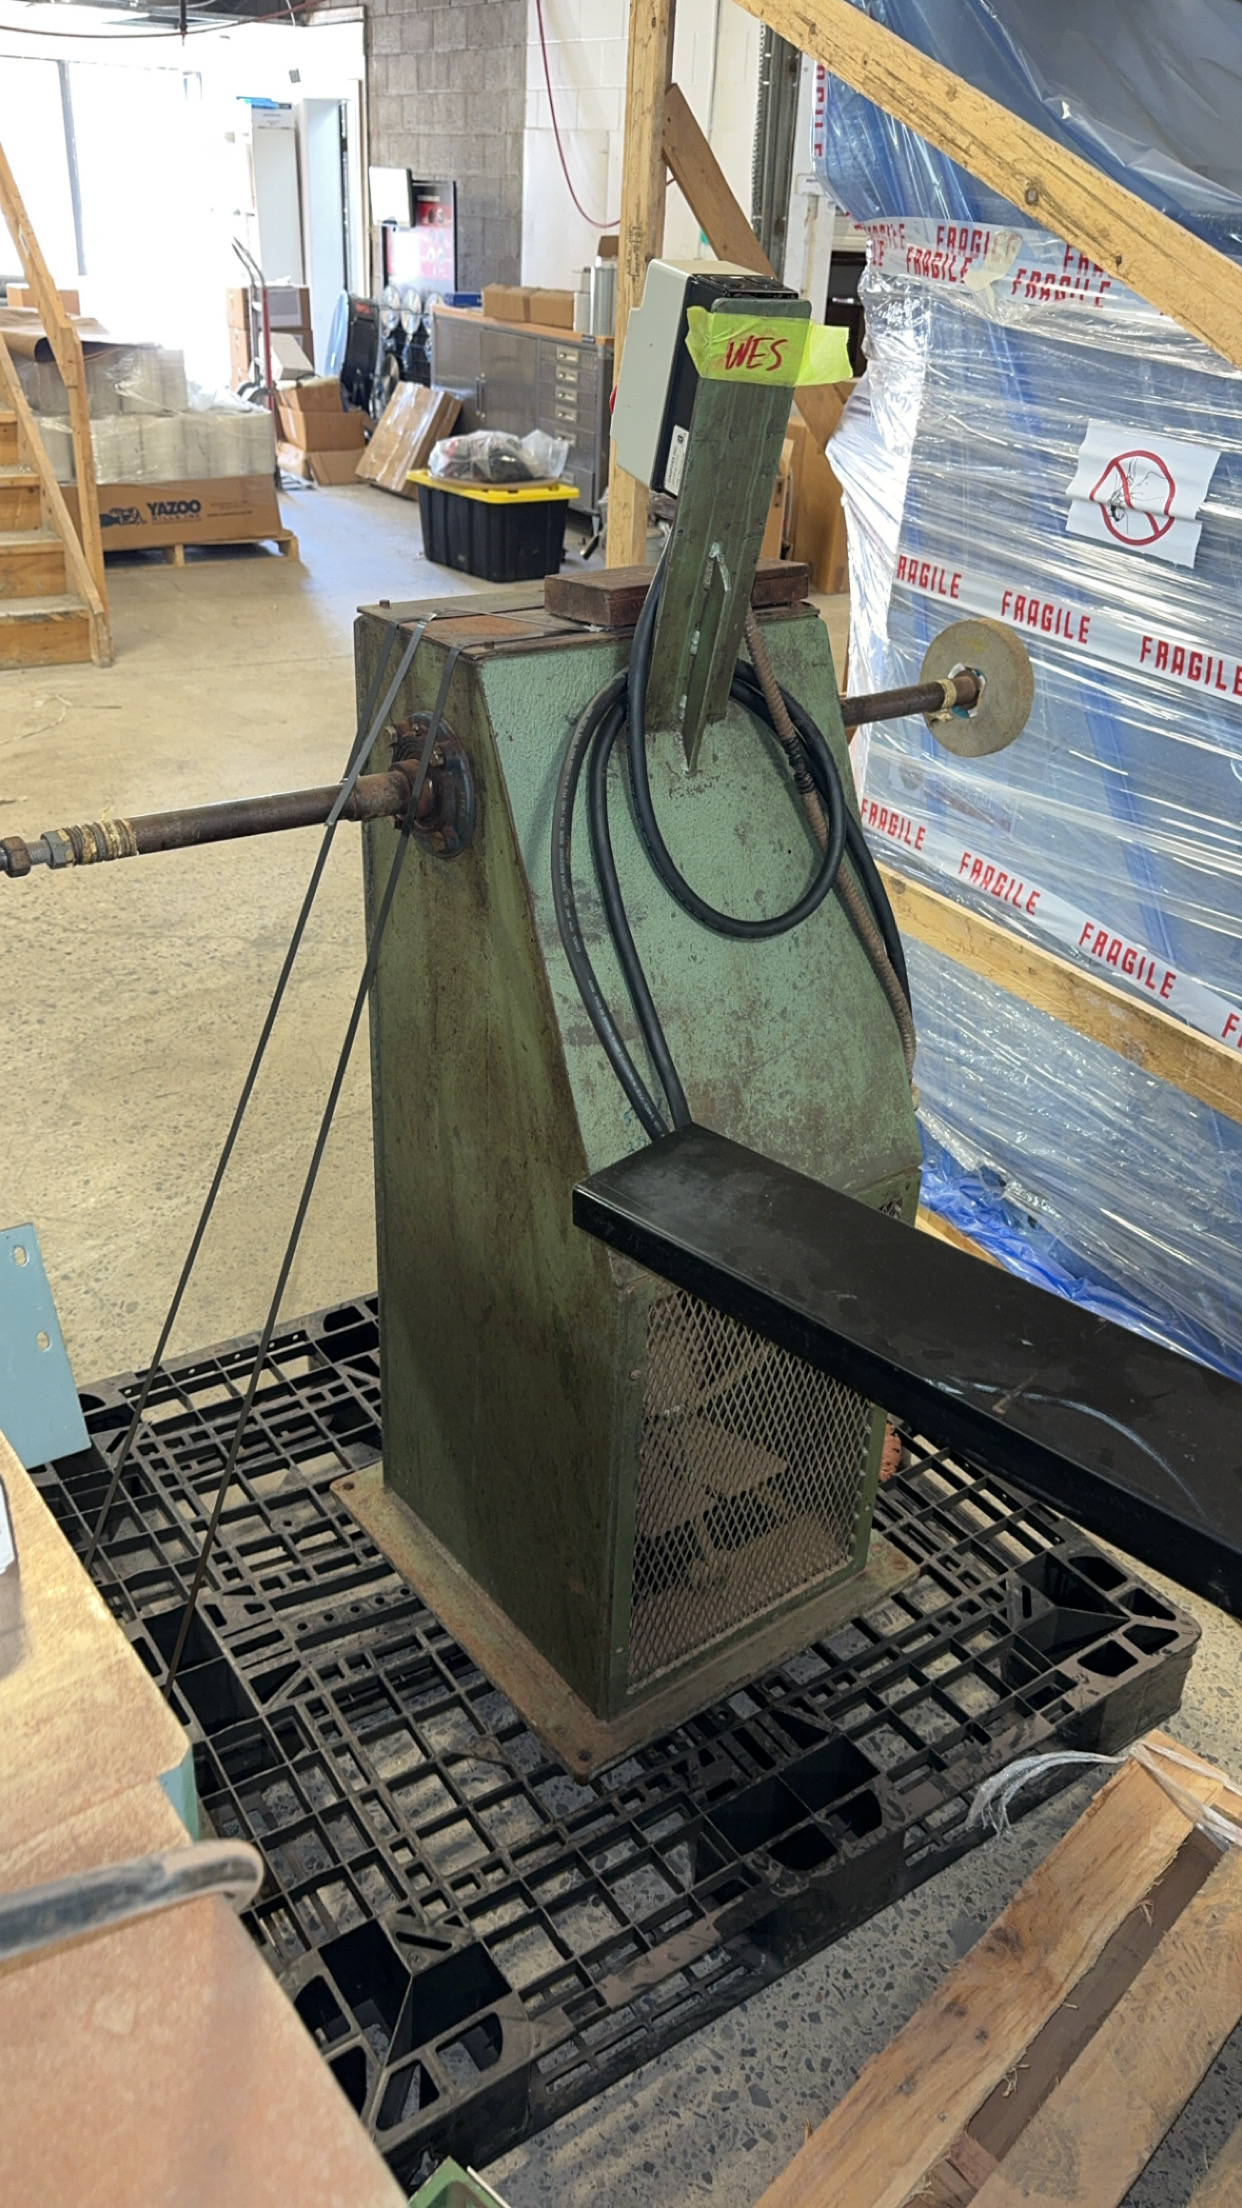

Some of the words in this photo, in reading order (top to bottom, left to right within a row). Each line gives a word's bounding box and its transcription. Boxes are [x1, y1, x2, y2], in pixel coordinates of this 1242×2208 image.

[906, 245, 973, 284] FRAGILE
[1011, 268, 1112, 308] FRAGILE
[725, 335, 788, 371] WES
[147, 500, 202, 516] YAZOO
[897, 555, 962, 599] RAGILE
[1001, 590, 1091, 645] FRAGILE
[1139, 635, 1242, 696] FRAGILE
[860, 798, 926, 851] FRAGILE
[958, 851, 1041, 916] FRAGILE
[1078, 921, 1177, 999] FRAGILE
